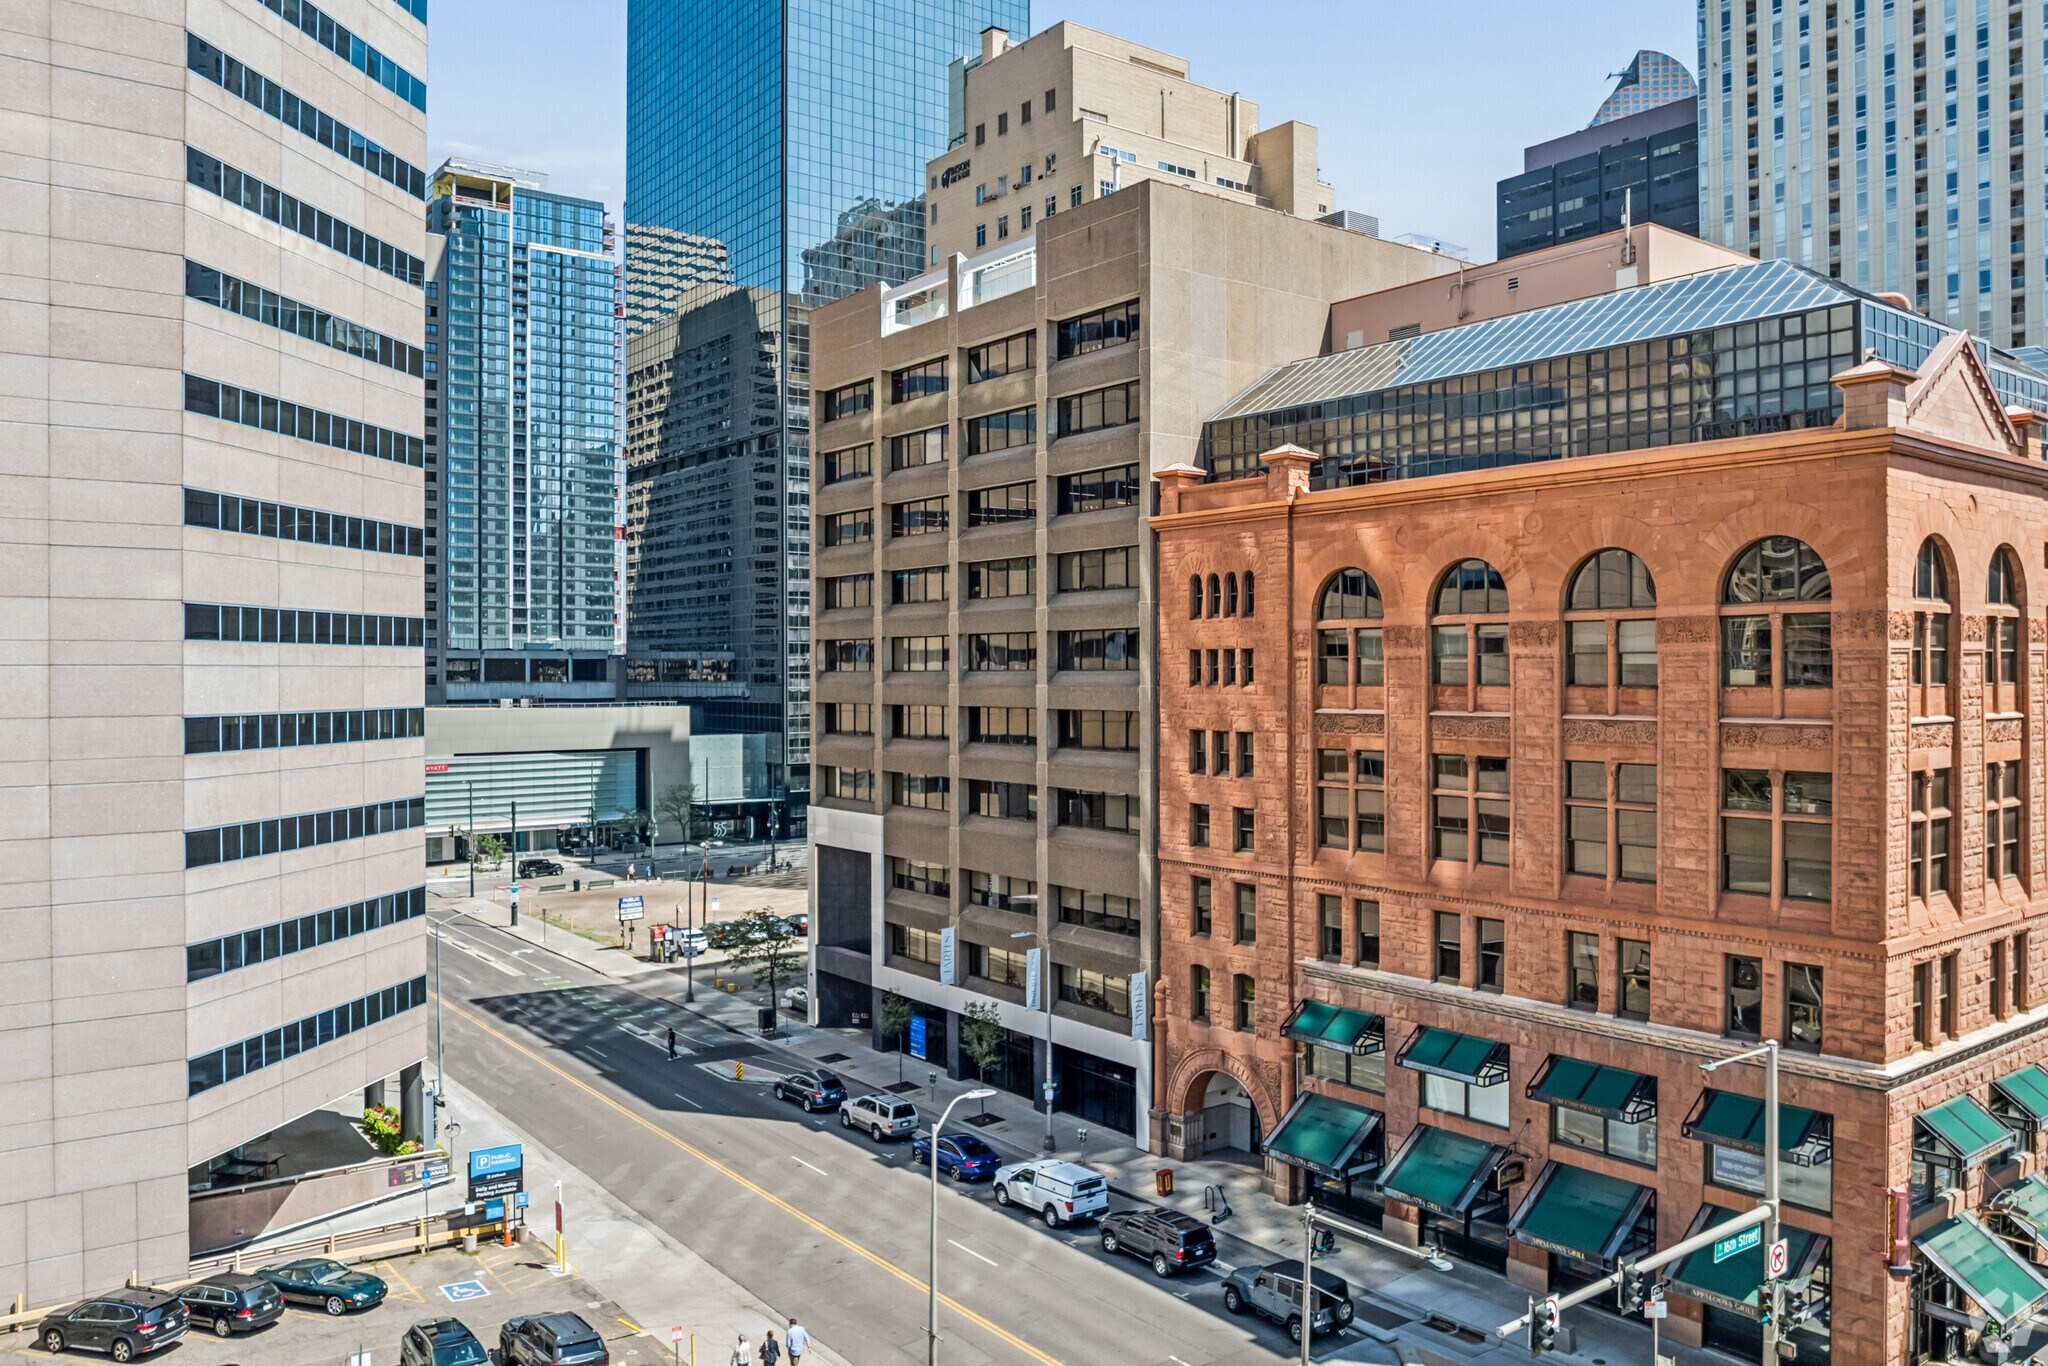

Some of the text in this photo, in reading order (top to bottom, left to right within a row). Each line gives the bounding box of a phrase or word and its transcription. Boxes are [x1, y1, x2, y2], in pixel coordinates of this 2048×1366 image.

[950, 159, 970, 175] BISON
[491, 1152, 511, 1160] PUBLIC
[491, 1157, 516, 1165] PARKING
[497, 1181, 518, 1189] Monthly
[476, 1187, 517, 1198] Parking Available
[1723, 1228, 1758, 1253] 16th Street
[1532, 1237, 1585, 1260] APPALOOSA GRILL
[1692, 1289, 1755, 1315] APPALOOSA GRILL
